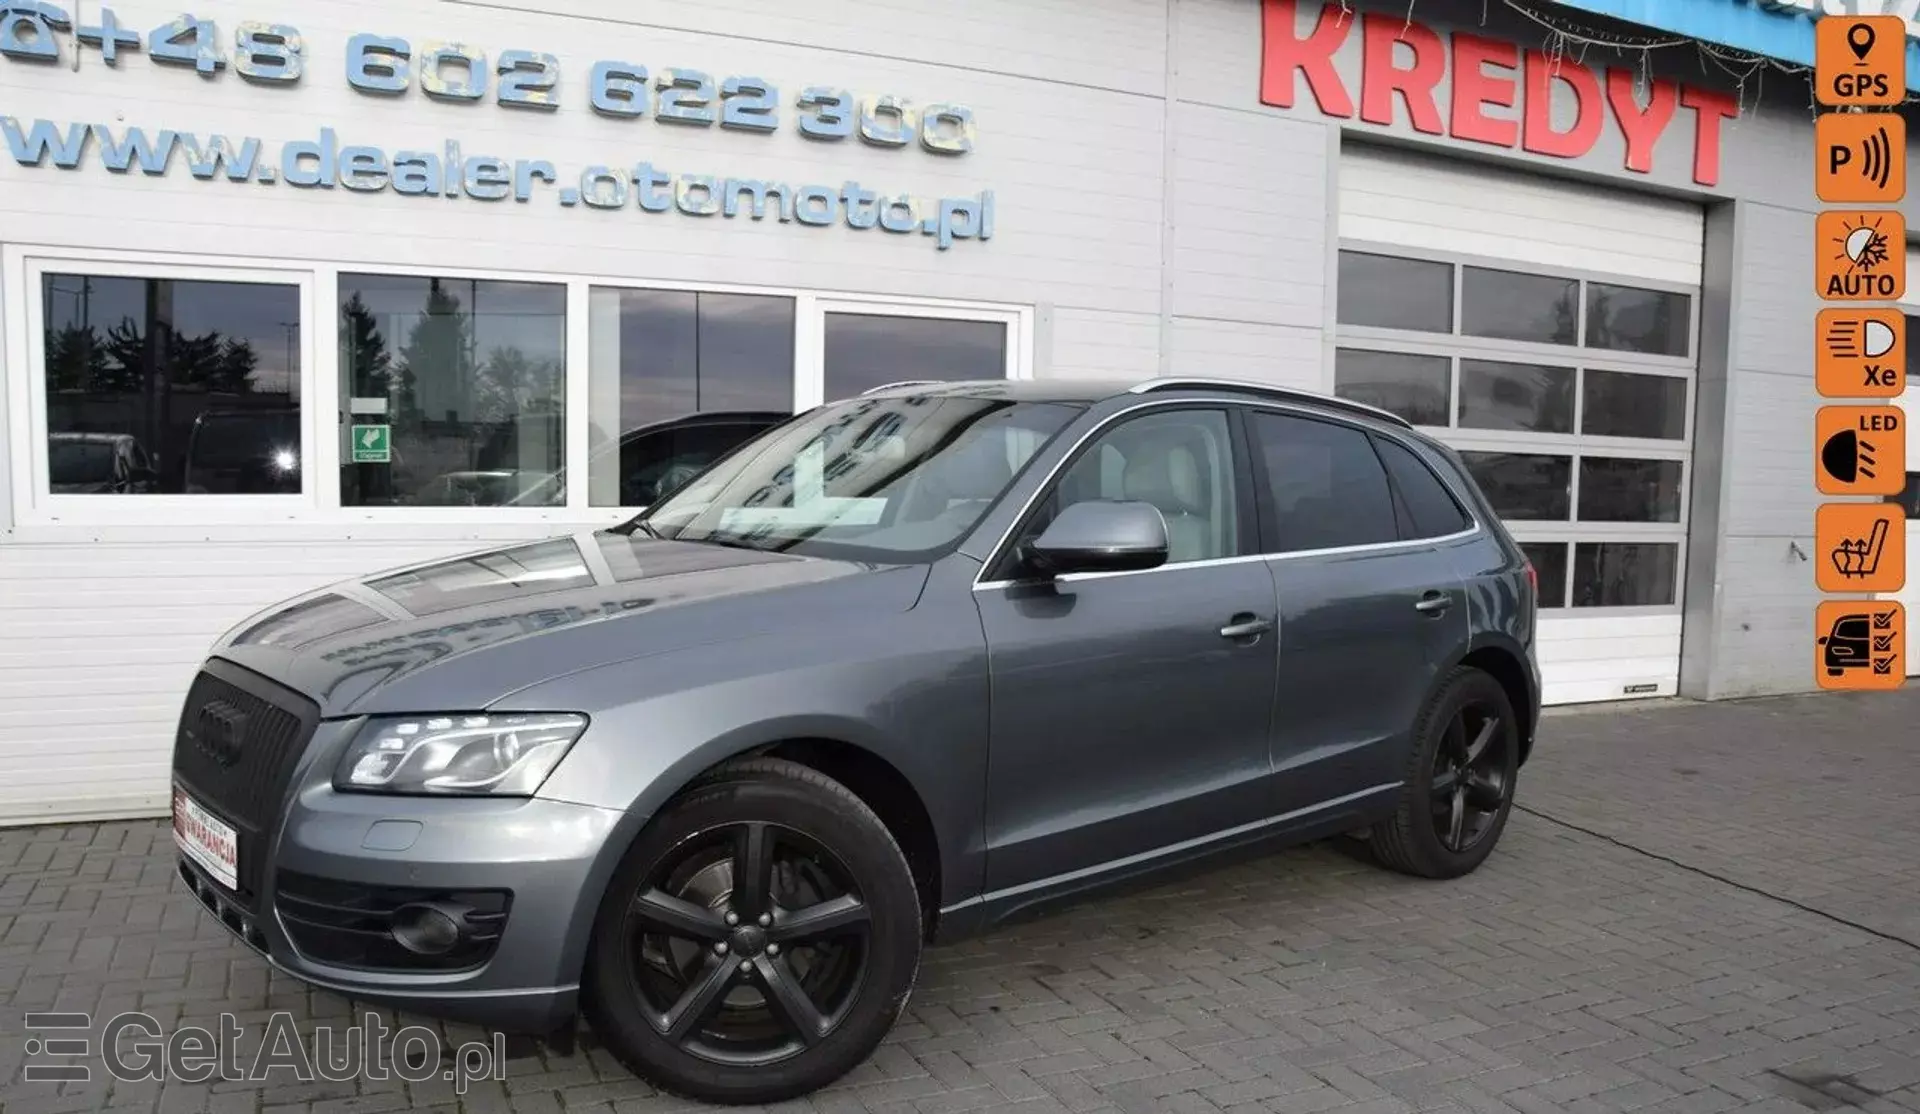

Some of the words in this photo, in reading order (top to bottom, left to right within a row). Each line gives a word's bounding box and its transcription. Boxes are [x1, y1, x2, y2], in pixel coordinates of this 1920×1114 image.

[76, 8, 304, 85] +48
[346, 32, 560, 111] 602
[589, 59, 780, 133] 622
[797, 85, 976, 155] 300
[1260, 0, 1738, 188] KREDYT
[0, 114, 995, 251] www.dealer.otomoto.pl
